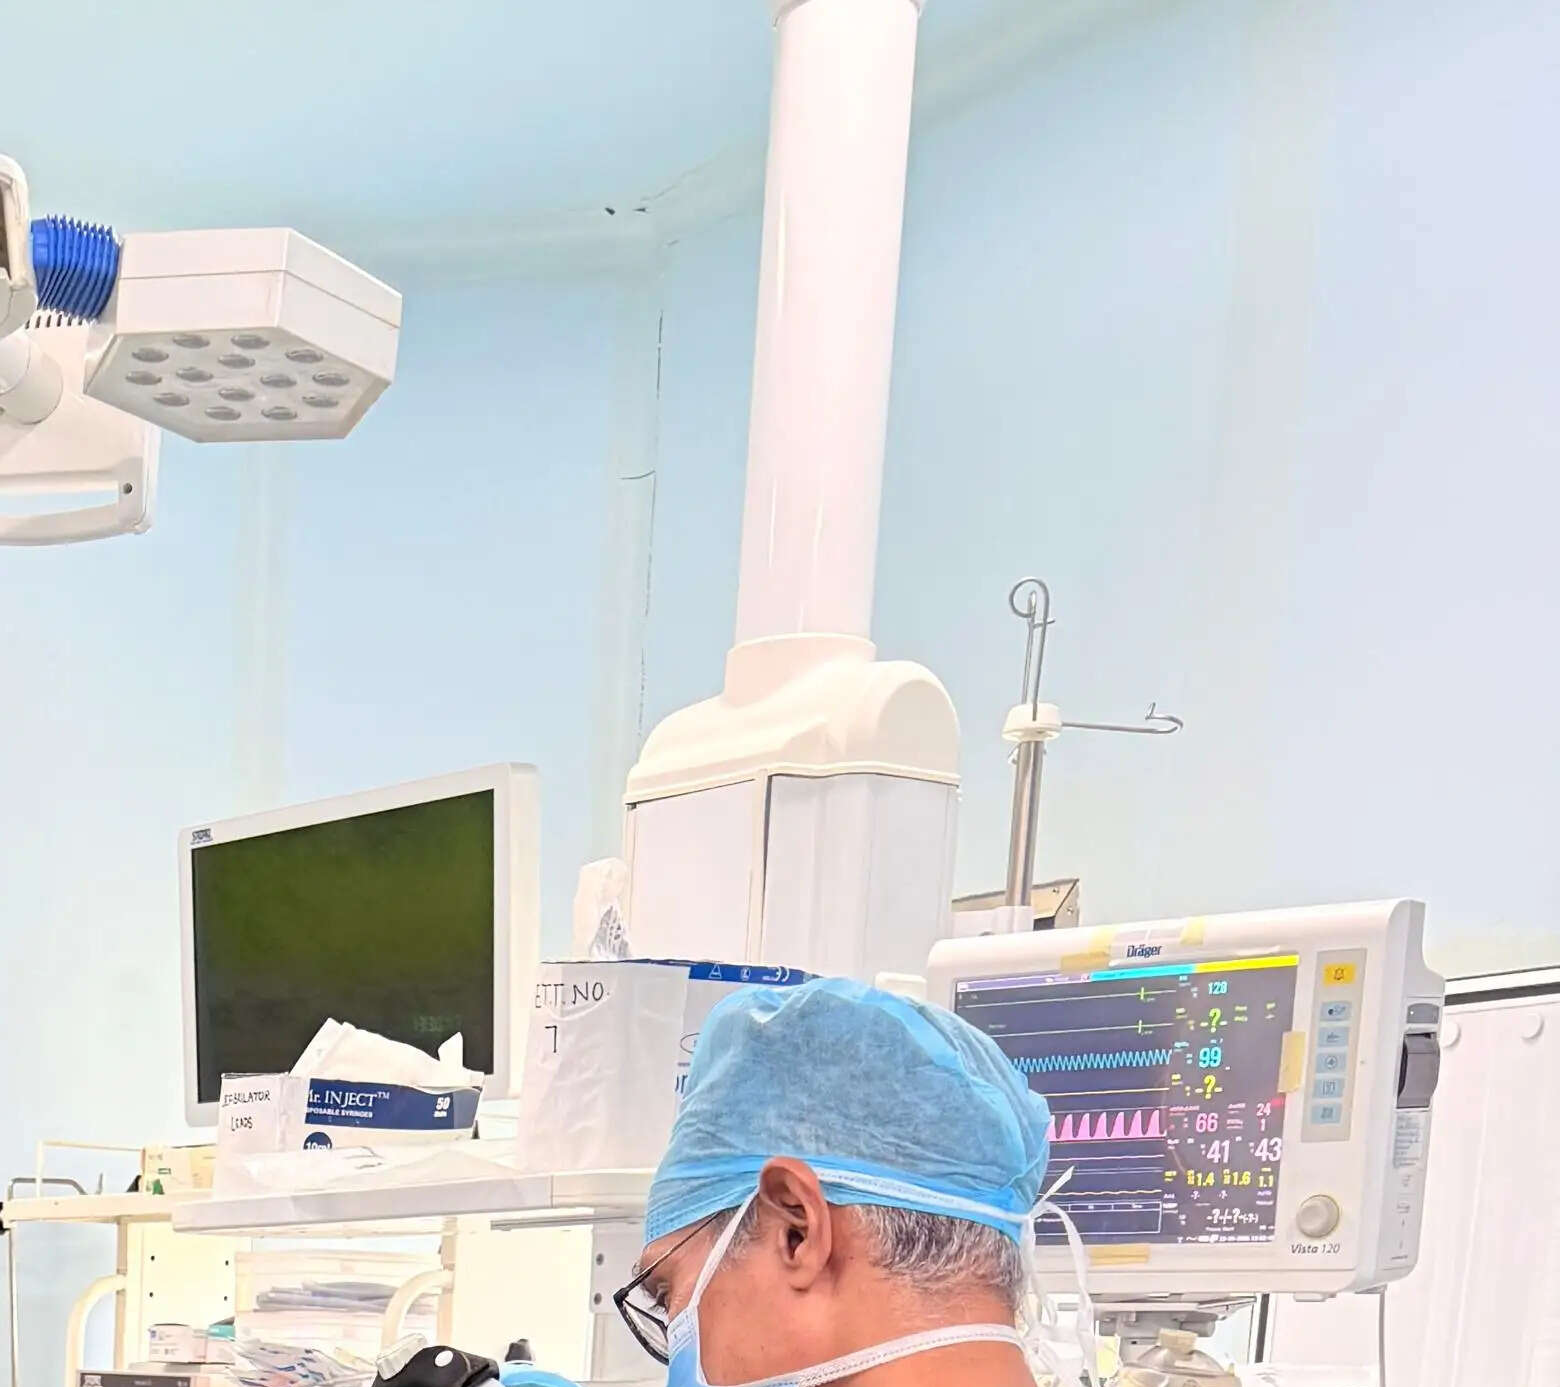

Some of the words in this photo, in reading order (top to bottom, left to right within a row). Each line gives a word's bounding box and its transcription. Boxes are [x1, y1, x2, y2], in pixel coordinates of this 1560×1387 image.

[1127, 944, 1162, 958] Dräger
[1198, 1046, 1222, 1069] 99
[1256, 1102, 1271, 1116] 24
[1195, 1112, 1219, 1133] 66
[1206, 1140, 1231, 1163] 41
[1254, 1137, 1282, 1162] 43
[1196, 1172, 1215, 1186] 1.4
[1232, 1171, 1252, 1186] 1.6
[1290, 1243, 1319, 1255] Vista
[1321, 1243, 1341, 1255] 120
